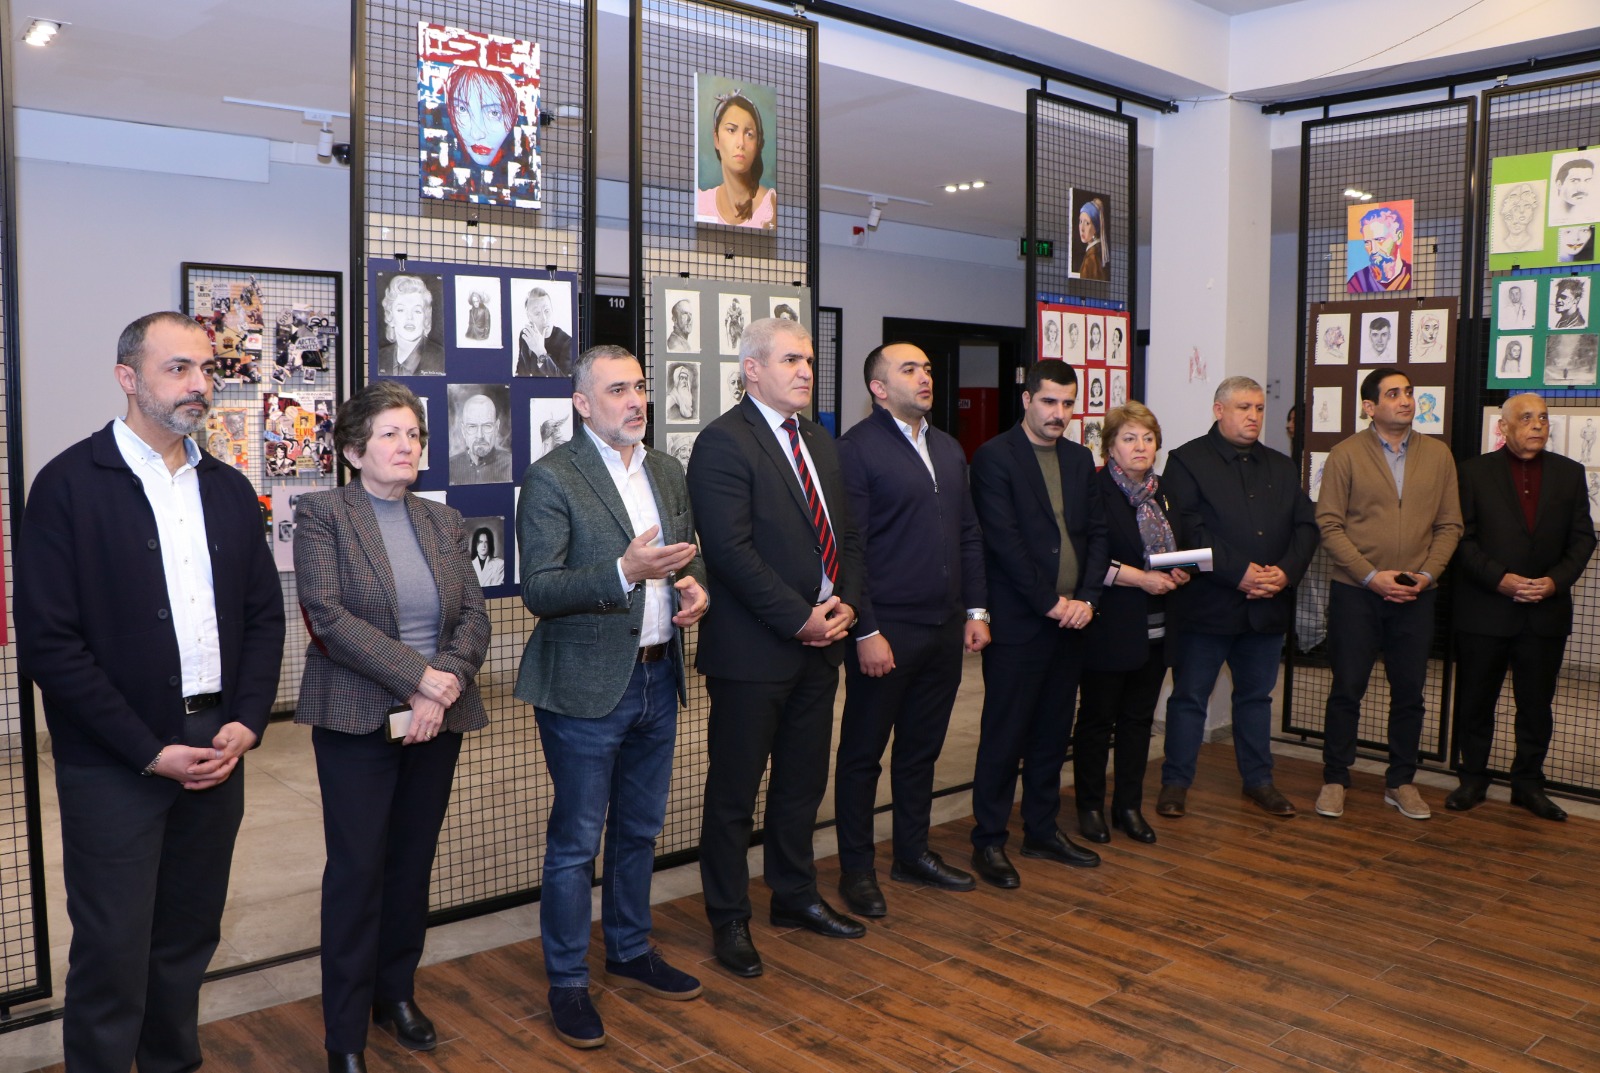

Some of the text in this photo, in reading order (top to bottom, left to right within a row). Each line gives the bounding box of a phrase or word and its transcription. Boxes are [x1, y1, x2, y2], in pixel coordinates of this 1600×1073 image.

[608, 297, 625, 308] 110
[279, 311, 292, 325] 505
[297, 337, 317, 345] ARCTIC
[295, 428, 315, 437] ELVIS
